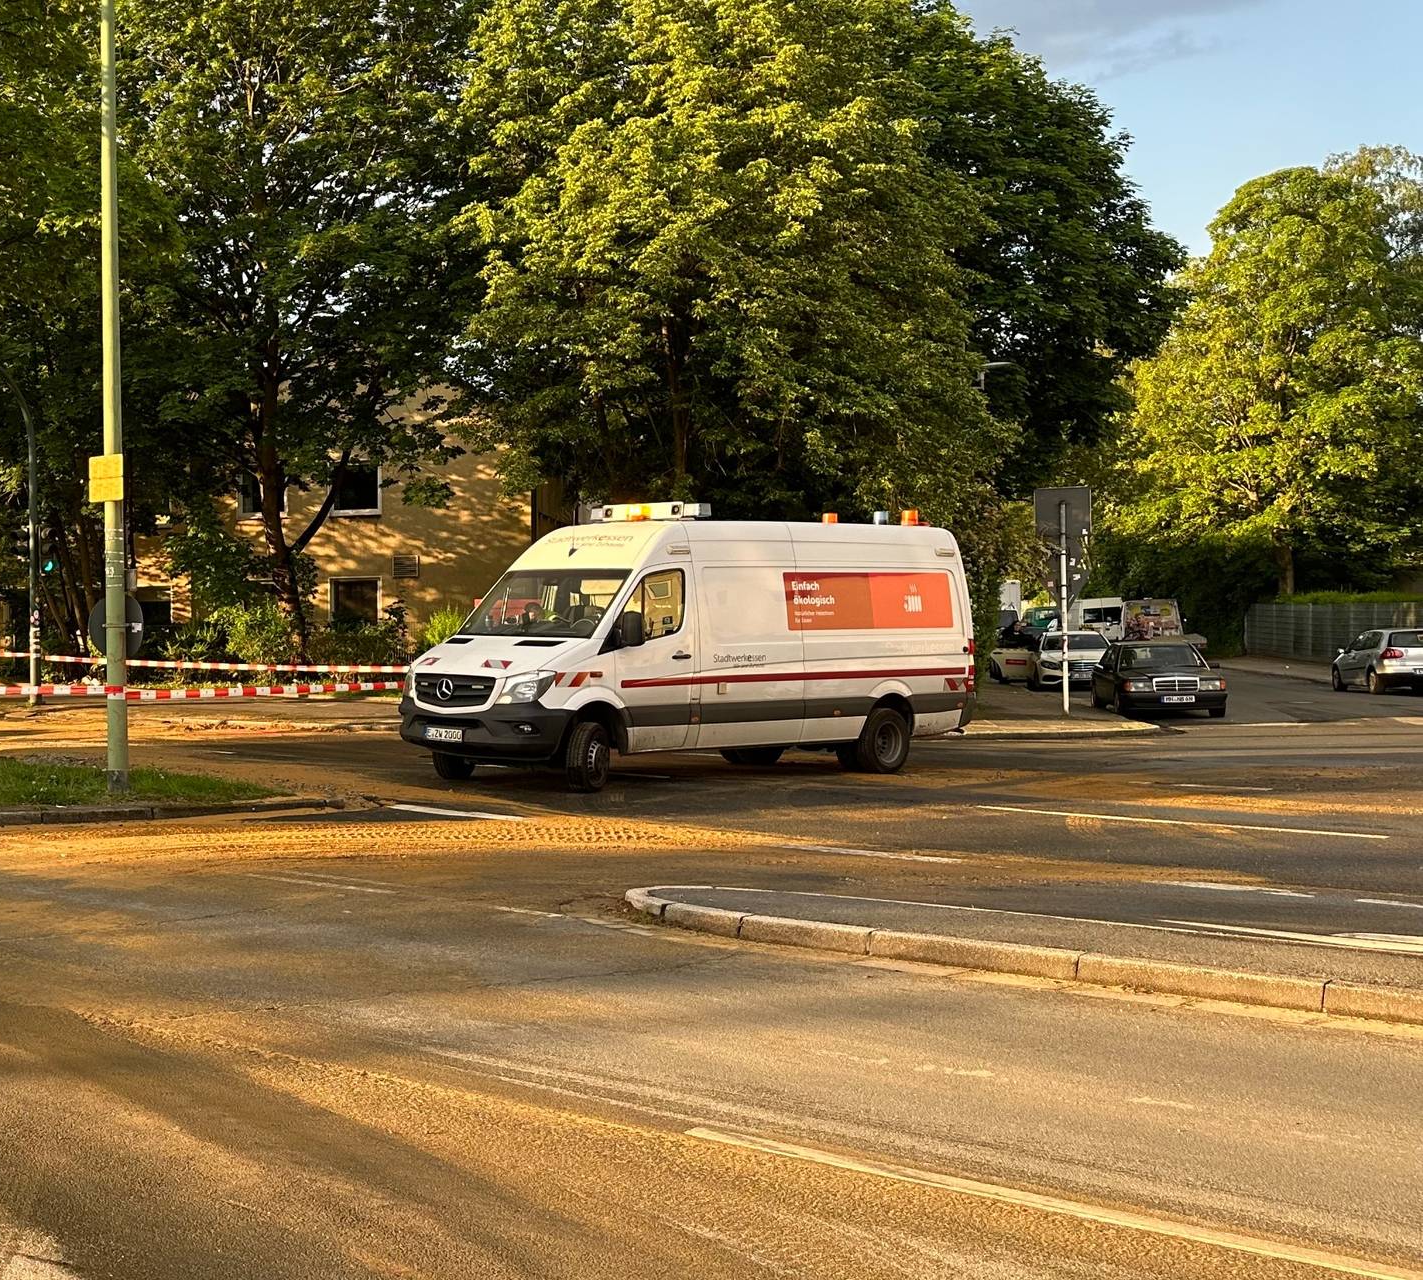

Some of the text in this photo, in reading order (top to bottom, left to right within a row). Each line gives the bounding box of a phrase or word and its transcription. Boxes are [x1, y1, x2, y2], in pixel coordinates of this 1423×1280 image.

[791, 581, 820, 591] Einfach
[793, 594, 835, 607] ökologisch
[713, 653, 767, 663] Stadtwerkessen
